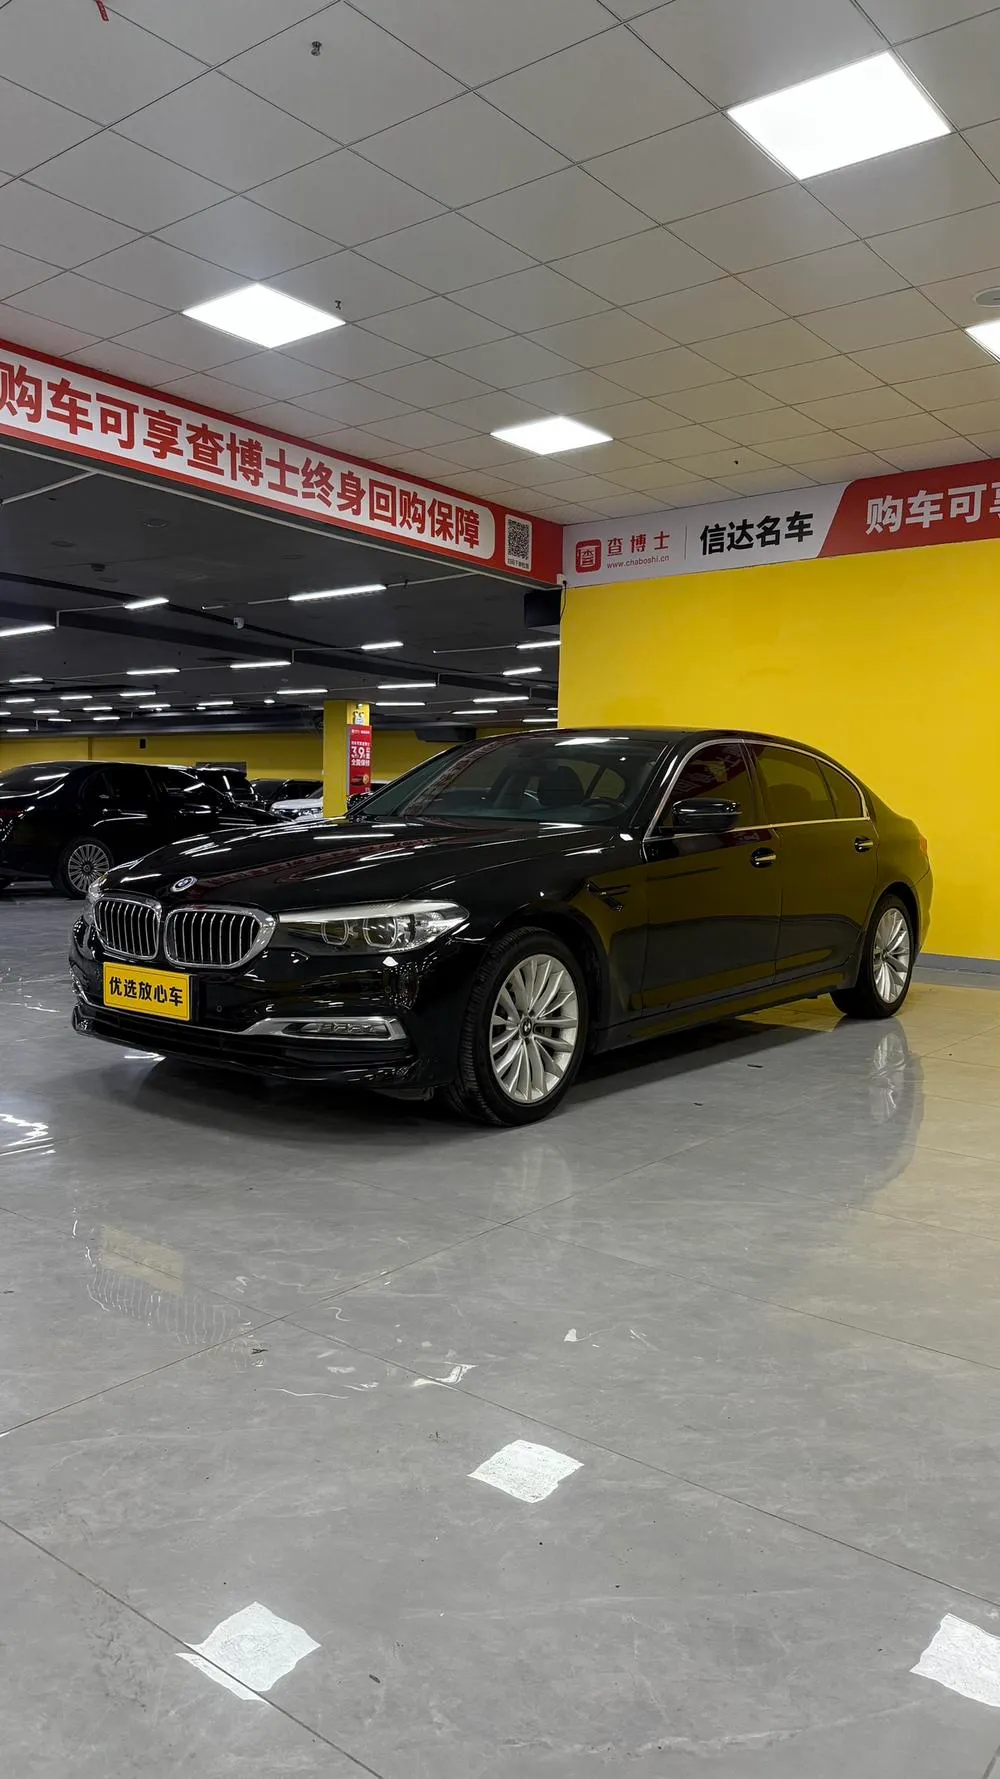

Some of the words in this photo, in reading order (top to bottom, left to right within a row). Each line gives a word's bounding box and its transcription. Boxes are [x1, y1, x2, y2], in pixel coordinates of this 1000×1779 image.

[0, 361, 479, 549] 购车可享查博士终身回购保障
[607, 531, 671, 557] 查博士
[700, 511, 814, 556] 信达名车
[606, 554, 670, 569] www.chaboshi.cn
[109, 976, 184, 1007] 优选放心车
